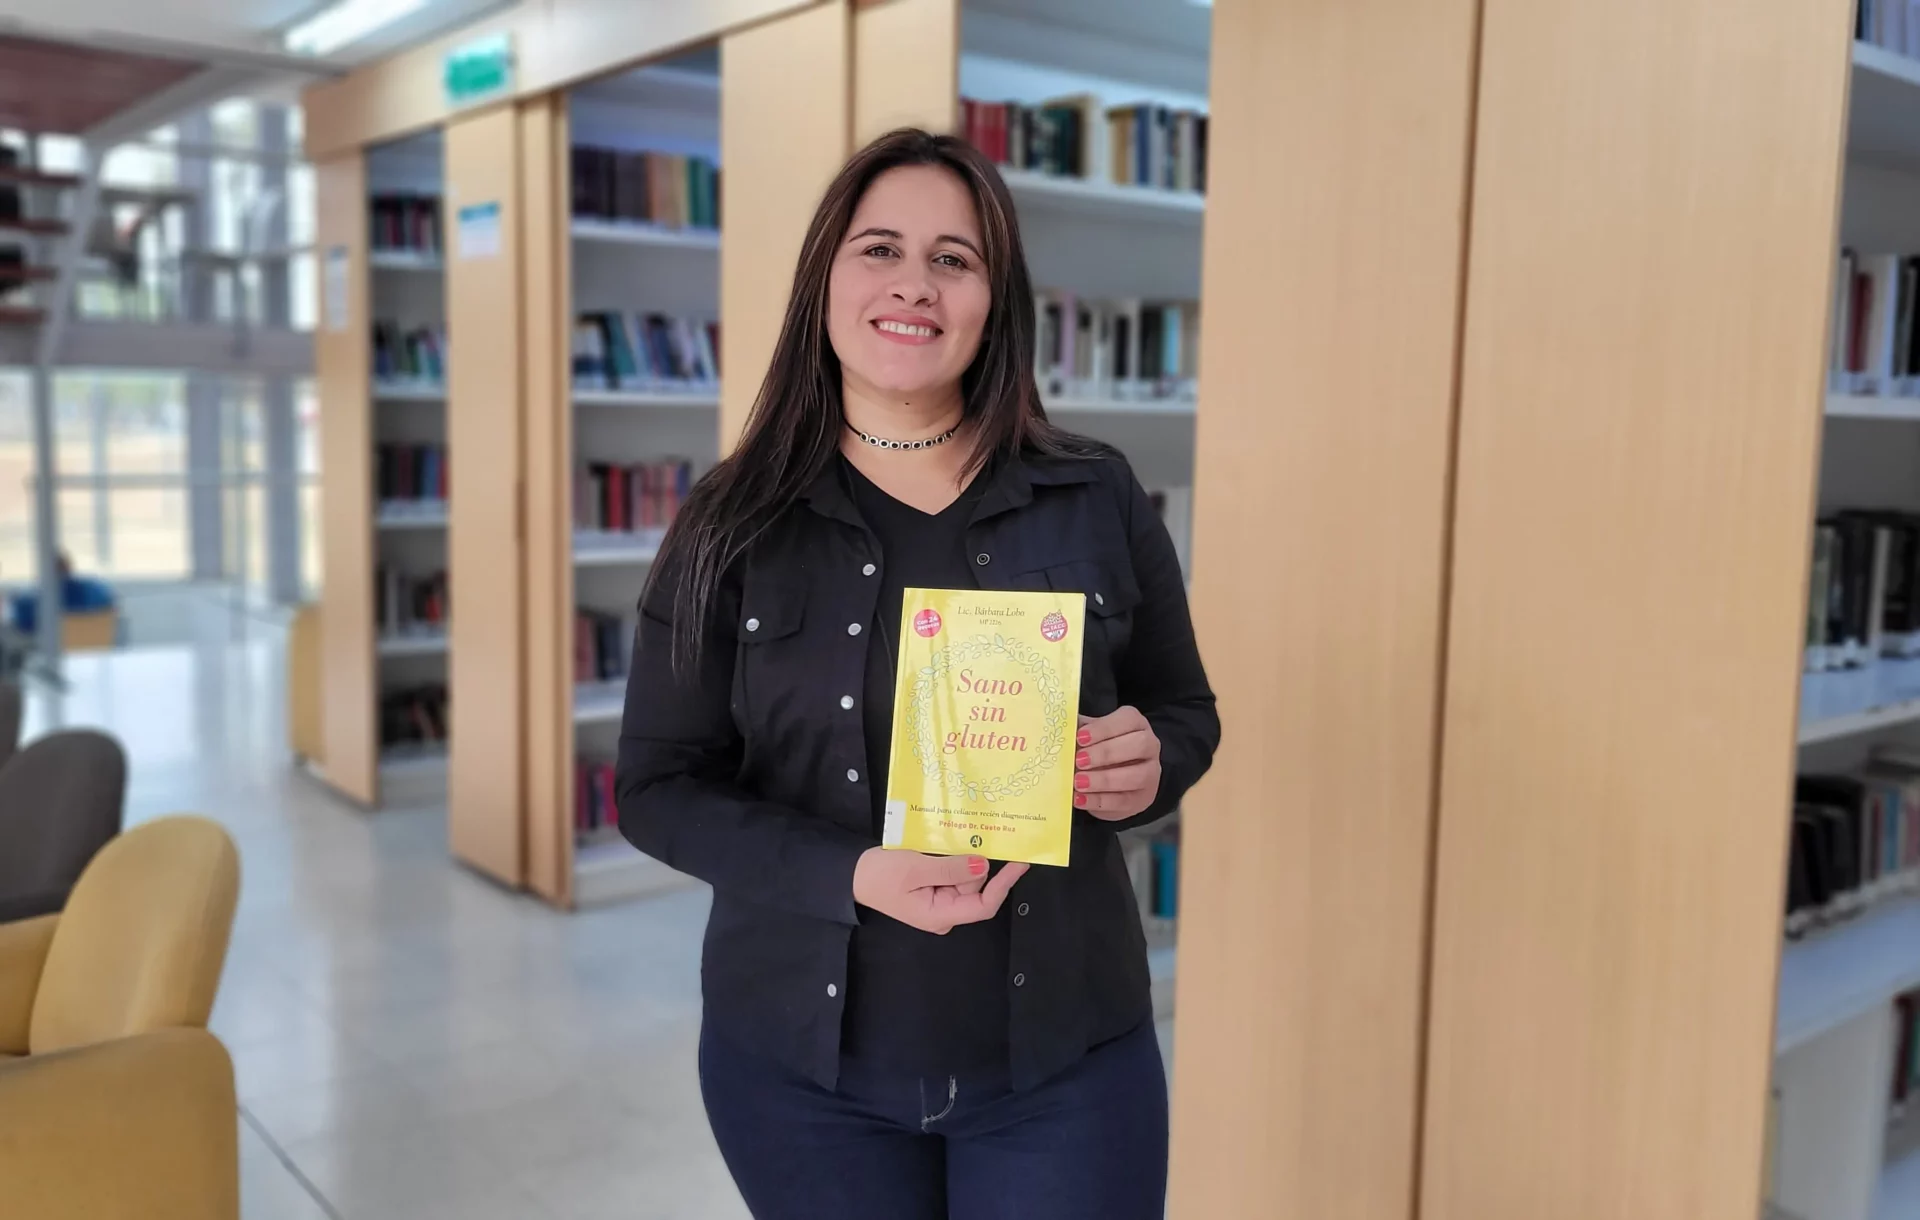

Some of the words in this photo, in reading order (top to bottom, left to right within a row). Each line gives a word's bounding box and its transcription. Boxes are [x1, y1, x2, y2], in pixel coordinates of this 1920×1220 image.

[957, 606, 972, 615] Lic.
[974, 606, 1004, 616] Bárbara
[1006, 607, 1025, 617] Lobo
[956, 668, 1023, 696] Sano
[969, 698, 1007, 722] sin
[942, 723, 1028, 755] gluten
[910, 804, 936, 814] Manual
[937, 806, 952, 815] para
[953, 807, 978, 817] celíacos
[980, 809, 1000, 818] recién
[1001, 810, 1047, 822] diagnosticados
[939, 820, 967, 830] Prólogo
[968, 822, 979, 831] Dr.
[980, 823, 1001, 832] Cueto
